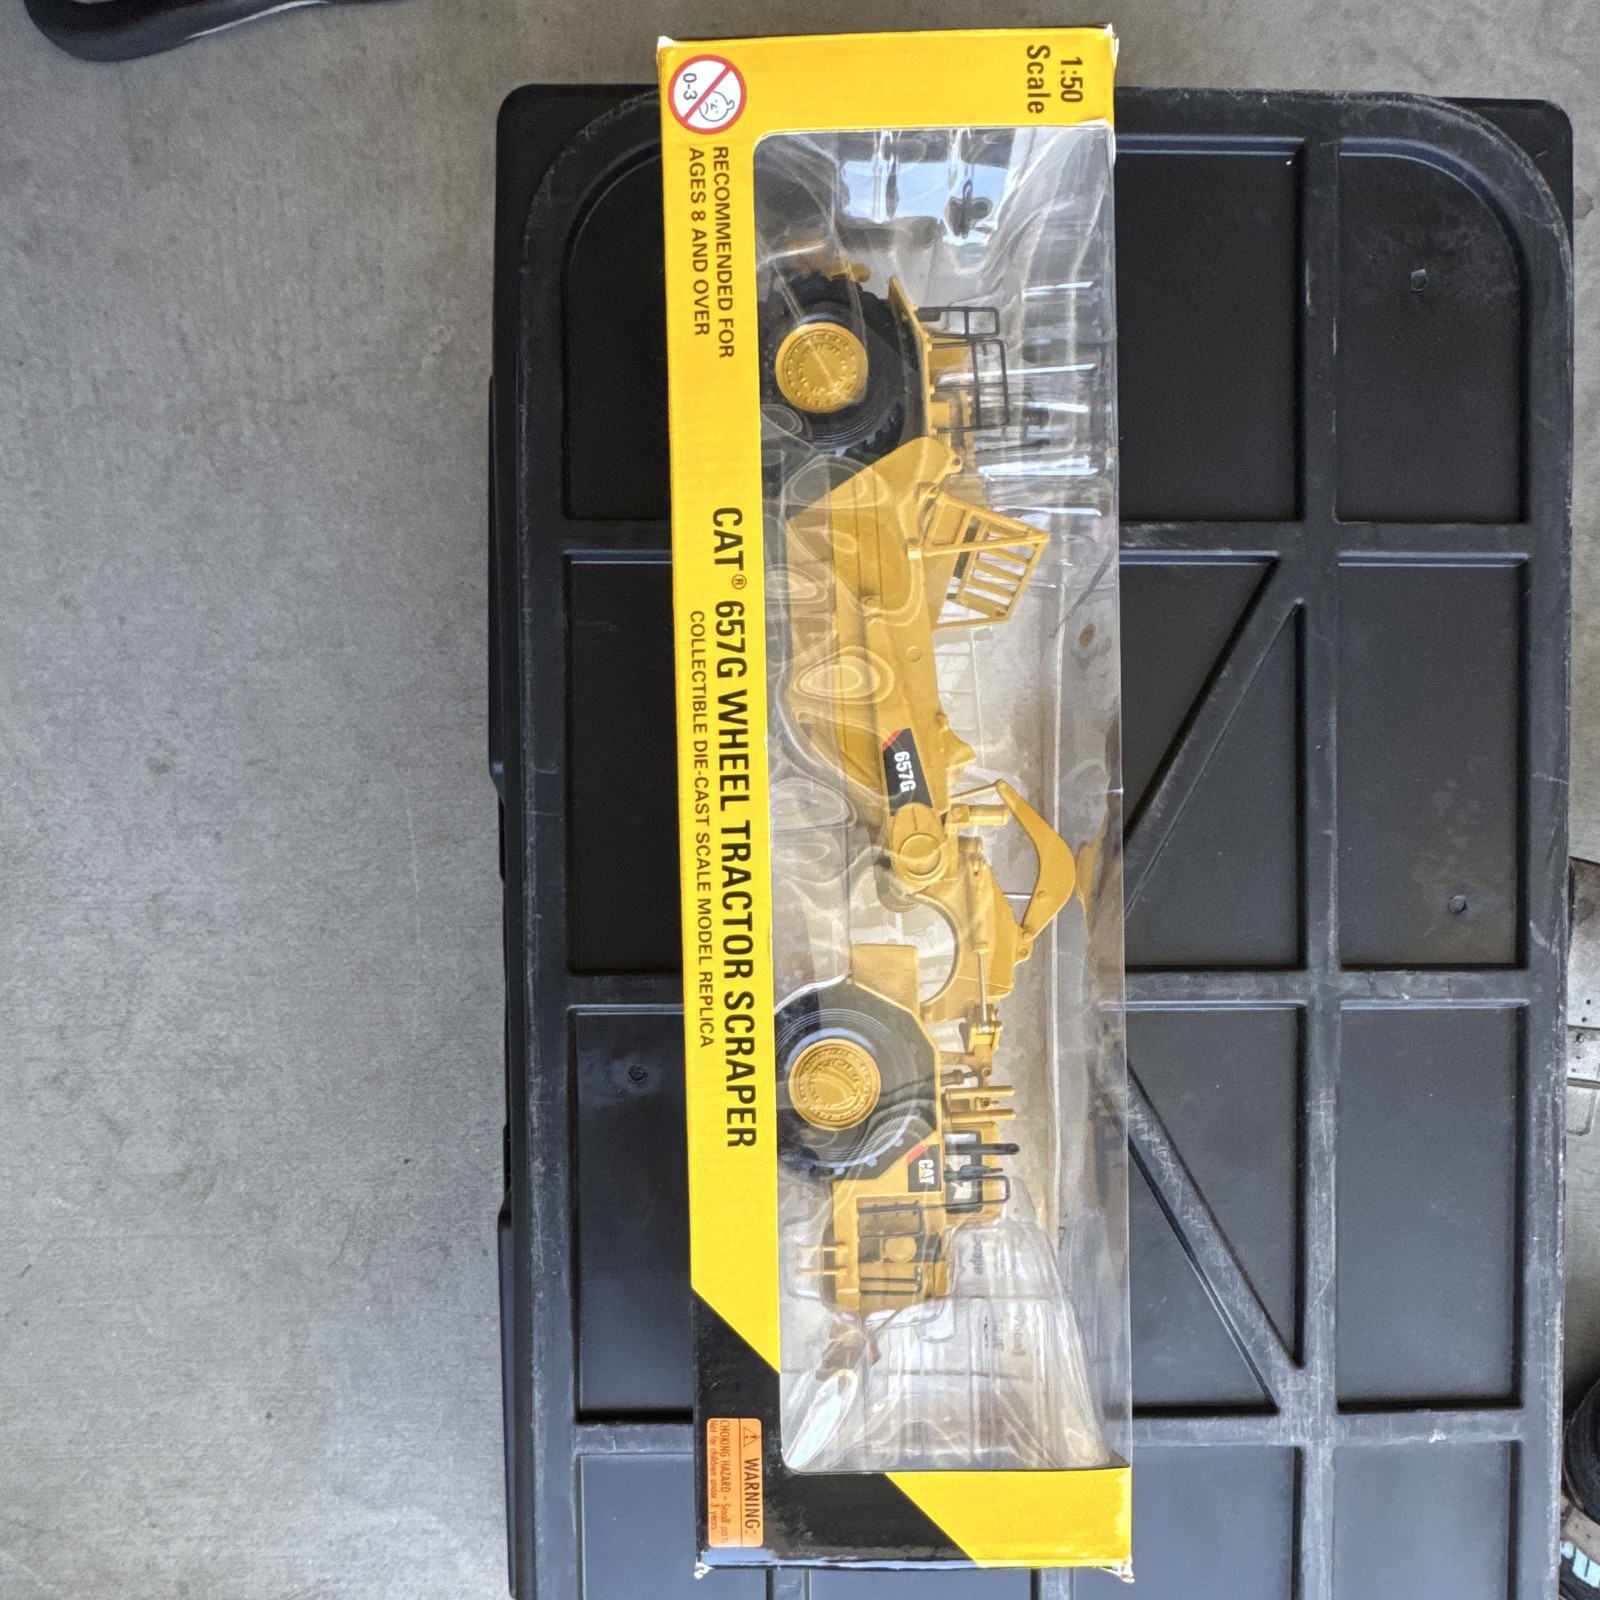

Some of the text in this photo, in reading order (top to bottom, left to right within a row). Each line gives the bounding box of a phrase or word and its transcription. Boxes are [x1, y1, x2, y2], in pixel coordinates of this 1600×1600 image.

[683, 72, 697, 100] 0-3
[1026, 44, 1051, 114] Scale
[1060, 56, 1084, 103] 1:50
[689, 147, 711, 336] AGES 8 AND OVER
[713, 146, 735, 358] RECOMMENDED FOR
[715, 600, 747, 679] 657G
[718, 689, 750, 812] WHEEL
[894, 751, 916, 792] 657G
[690, 610, 714, 1048] COLLECTIBLE DIE-CAST SCALE MODEL REPLICA
[720, 819, 754, 979] TRACTOR
[724, 990, 757, 1147] SCRAPER
[918, 1159, 934, 1184] CAT
[710, 1448, 719, 1476] children
[720, 1420, 730, 1457] CHOKING
[720, 1460, 731, 1493] HAZARD
[720, 1503, 731, 1523] Small
